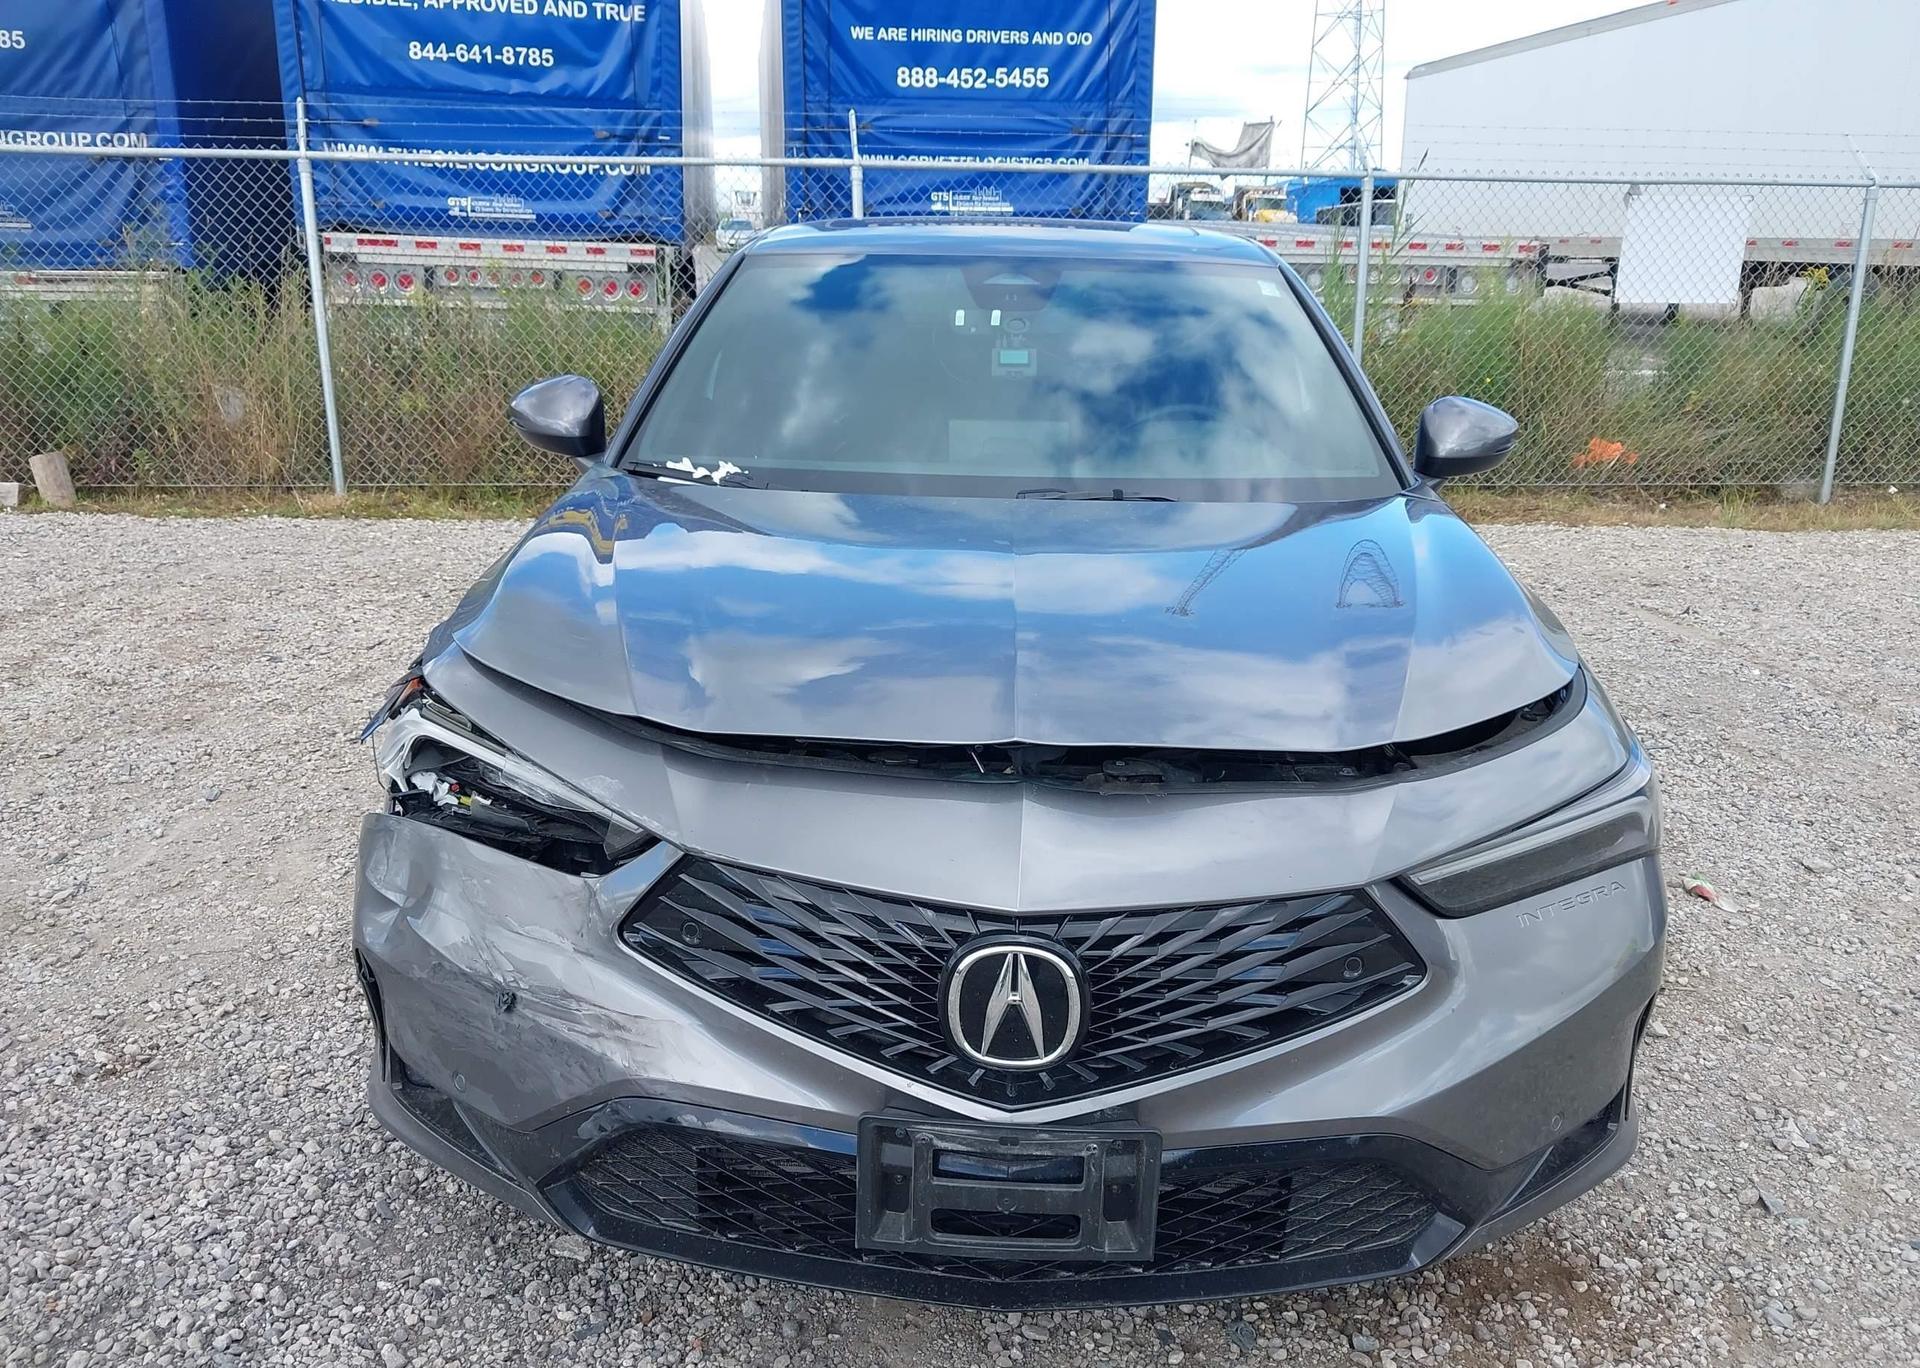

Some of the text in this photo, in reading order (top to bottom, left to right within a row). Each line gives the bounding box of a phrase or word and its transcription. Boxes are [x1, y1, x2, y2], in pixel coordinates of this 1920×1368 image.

[543, 0, 588, 18] AND
[592, 2, 646, 22] TRUE
[850, 26, 1093, 46] WE ARE HIRING DRIVERS AND O/O
[408, 41, 555, 67] 844-641-8785
[896, 66, 1050, 89] 888-452-5455
[0, 129, 148, 148] GROUPCOM
[1516, 880, 1626, 928] INTEGRA
